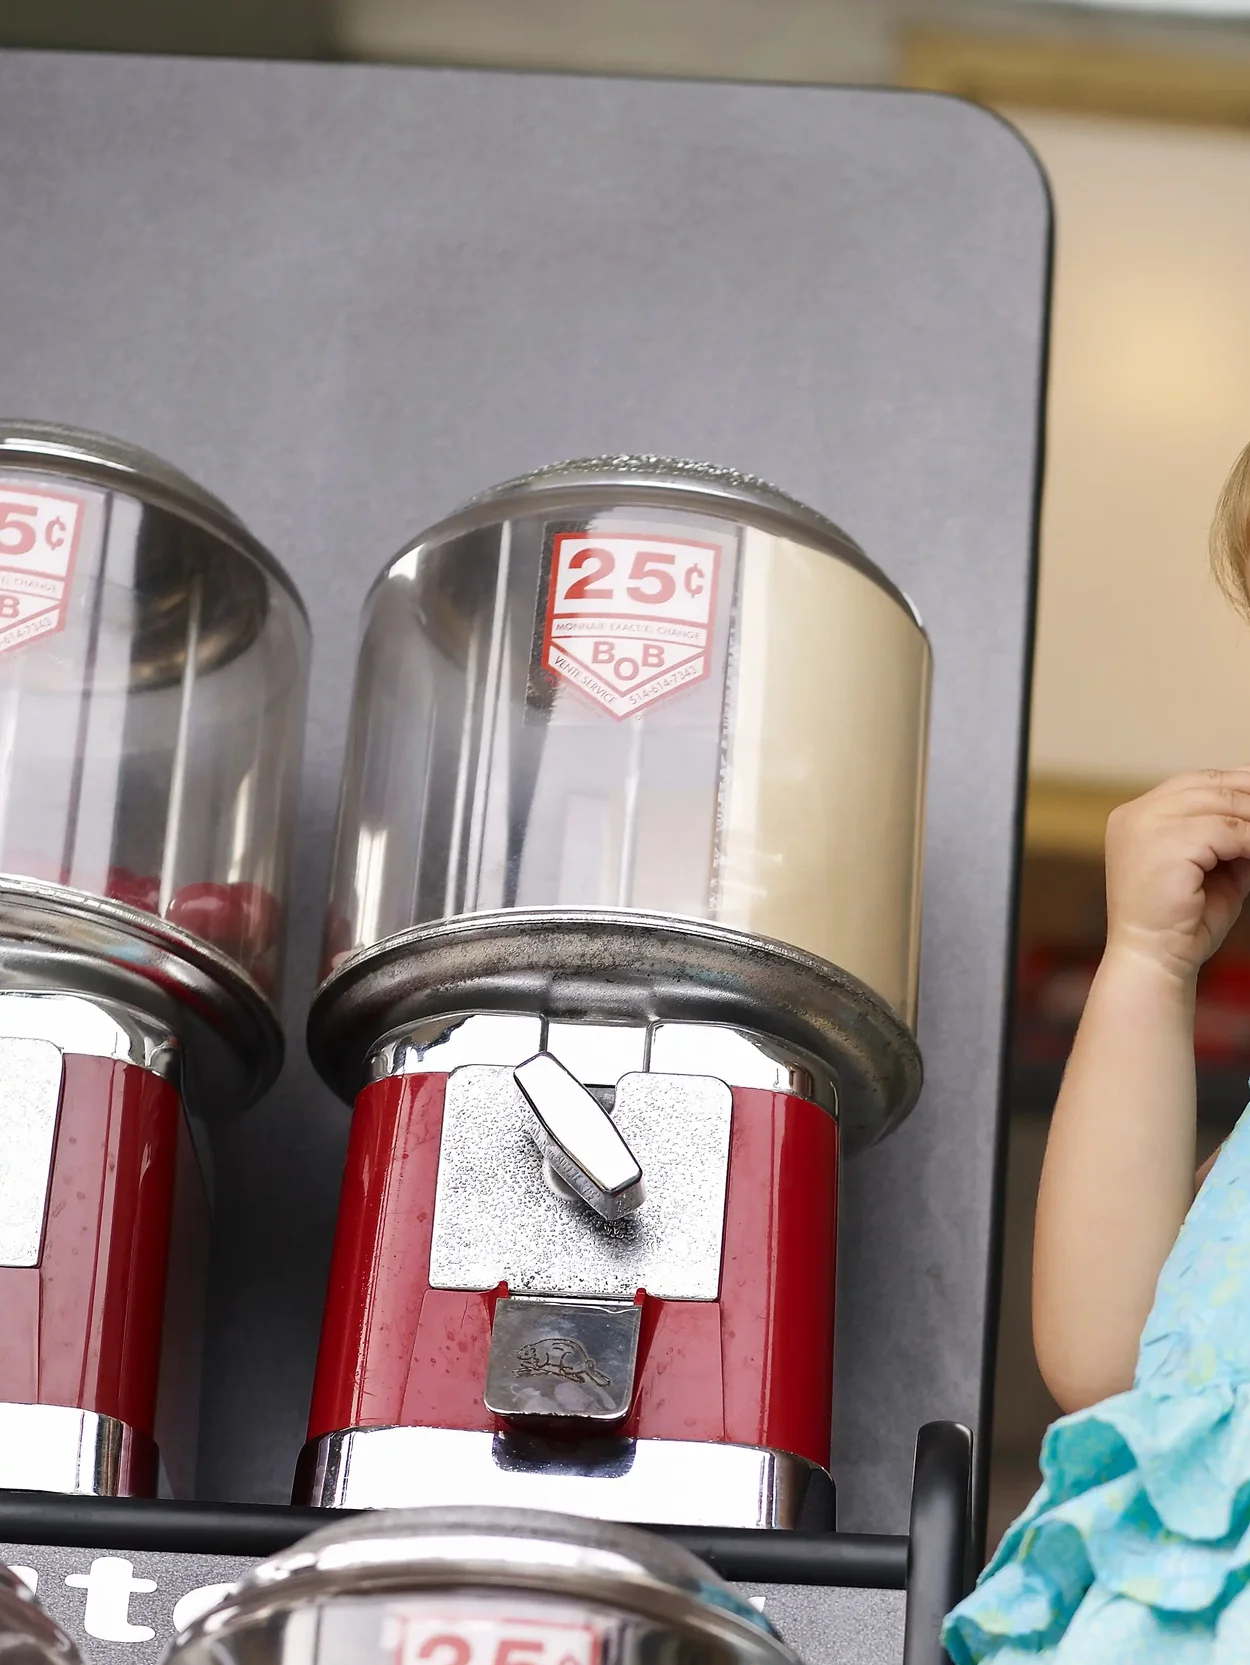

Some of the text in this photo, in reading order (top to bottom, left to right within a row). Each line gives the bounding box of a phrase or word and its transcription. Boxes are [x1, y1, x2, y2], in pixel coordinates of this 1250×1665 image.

[0, 502, 67, 555] 5¢
[563, 547, 705, 604] 25¢
[555, 622, 605, 632] MONNAIE
[657, 626, 700, 640] CHANGE
[554, 655, 580, 682] VENTE
[582, 676, 617, 705] SERVICE
